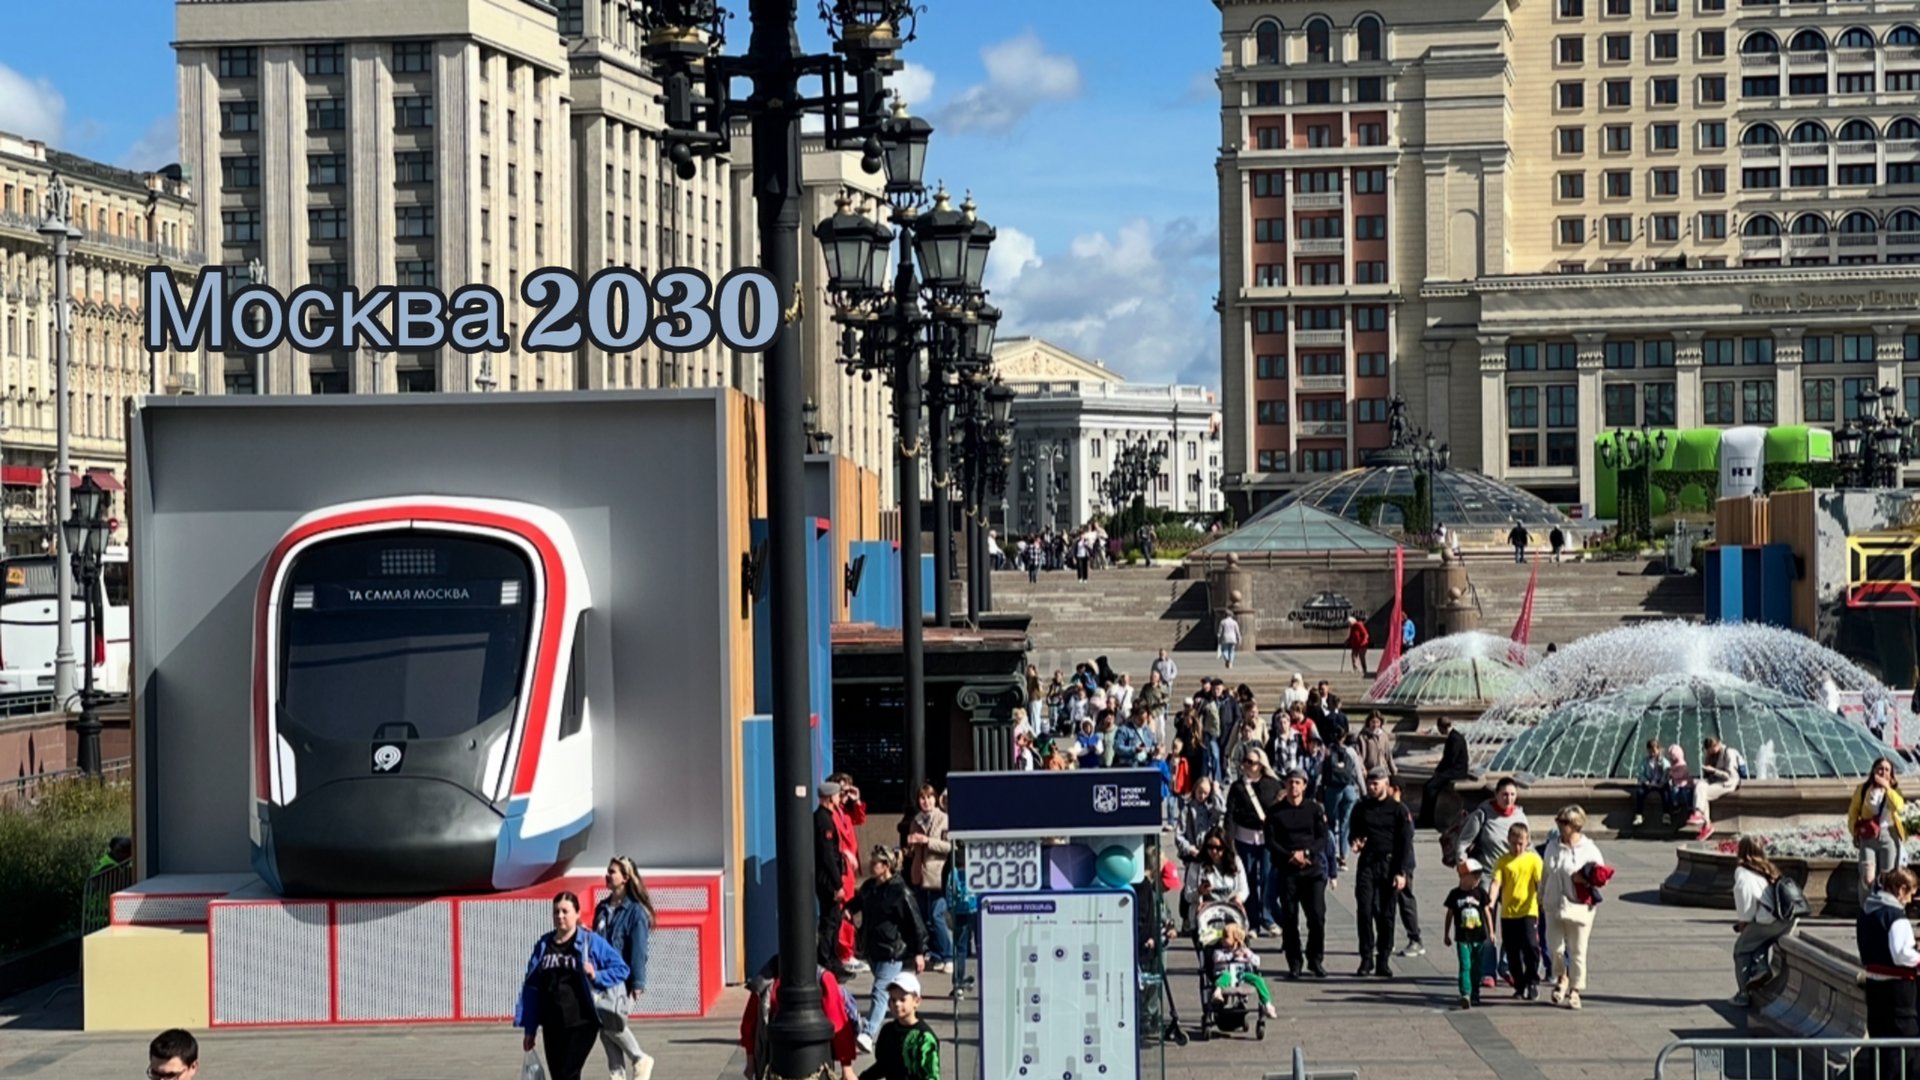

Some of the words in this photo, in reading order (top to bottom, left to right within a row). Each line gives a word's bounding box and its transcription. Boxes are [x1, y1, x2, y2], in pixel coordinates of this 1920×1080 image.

[349, 590, 362, 600] ТА
[365, 589, 410, 600] САМАЯ
[413, 588, 470, 600] МОСКВА
[968, 840, 1037, 860] МОСКВА
[969, 861, 1038, 889] 2030
